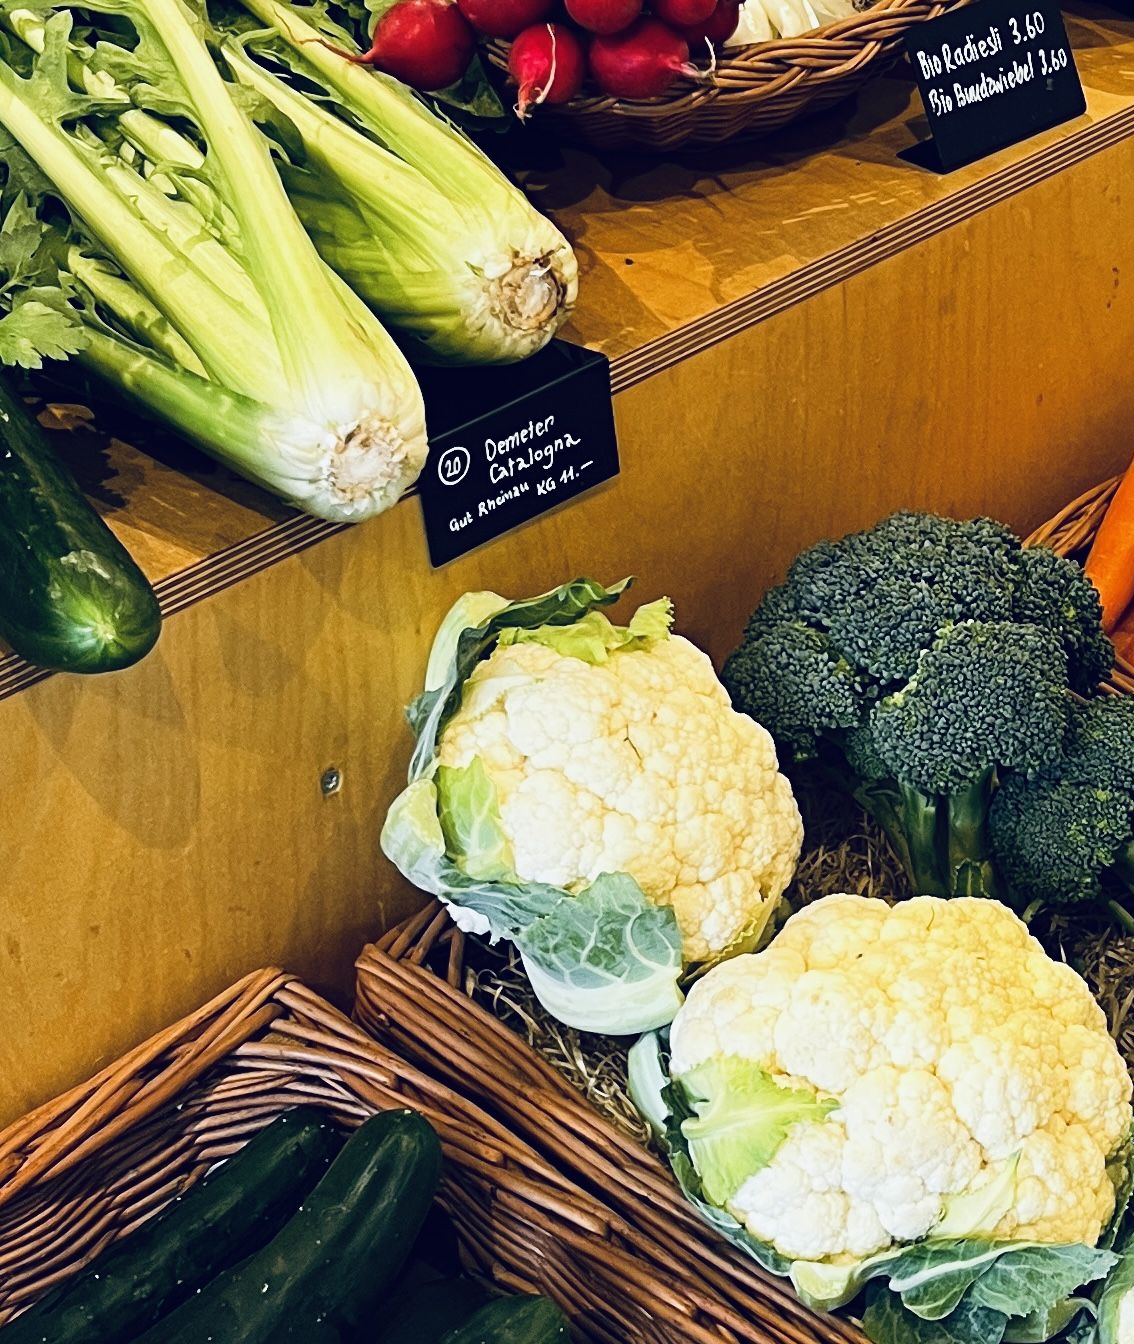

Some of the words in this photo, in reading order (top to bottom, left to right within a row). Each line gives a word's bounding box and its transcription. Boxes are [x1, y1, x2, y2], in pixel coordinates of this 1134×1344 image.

[917, 51, 942, 80] Bio
[942, 26, 1003, 73] Radiesli
[1008, 12, 1045, 44] 3.60
[928, 89, 952, 116] Bio
[1038, 48, 1067, 76] 3.60
[484, 415, 555, 461] Demeter
[489, 433, 581, 484] Catalogna
[449, 511, 474, 532] Gut
[478, 482, 530, 517] Rheinau
